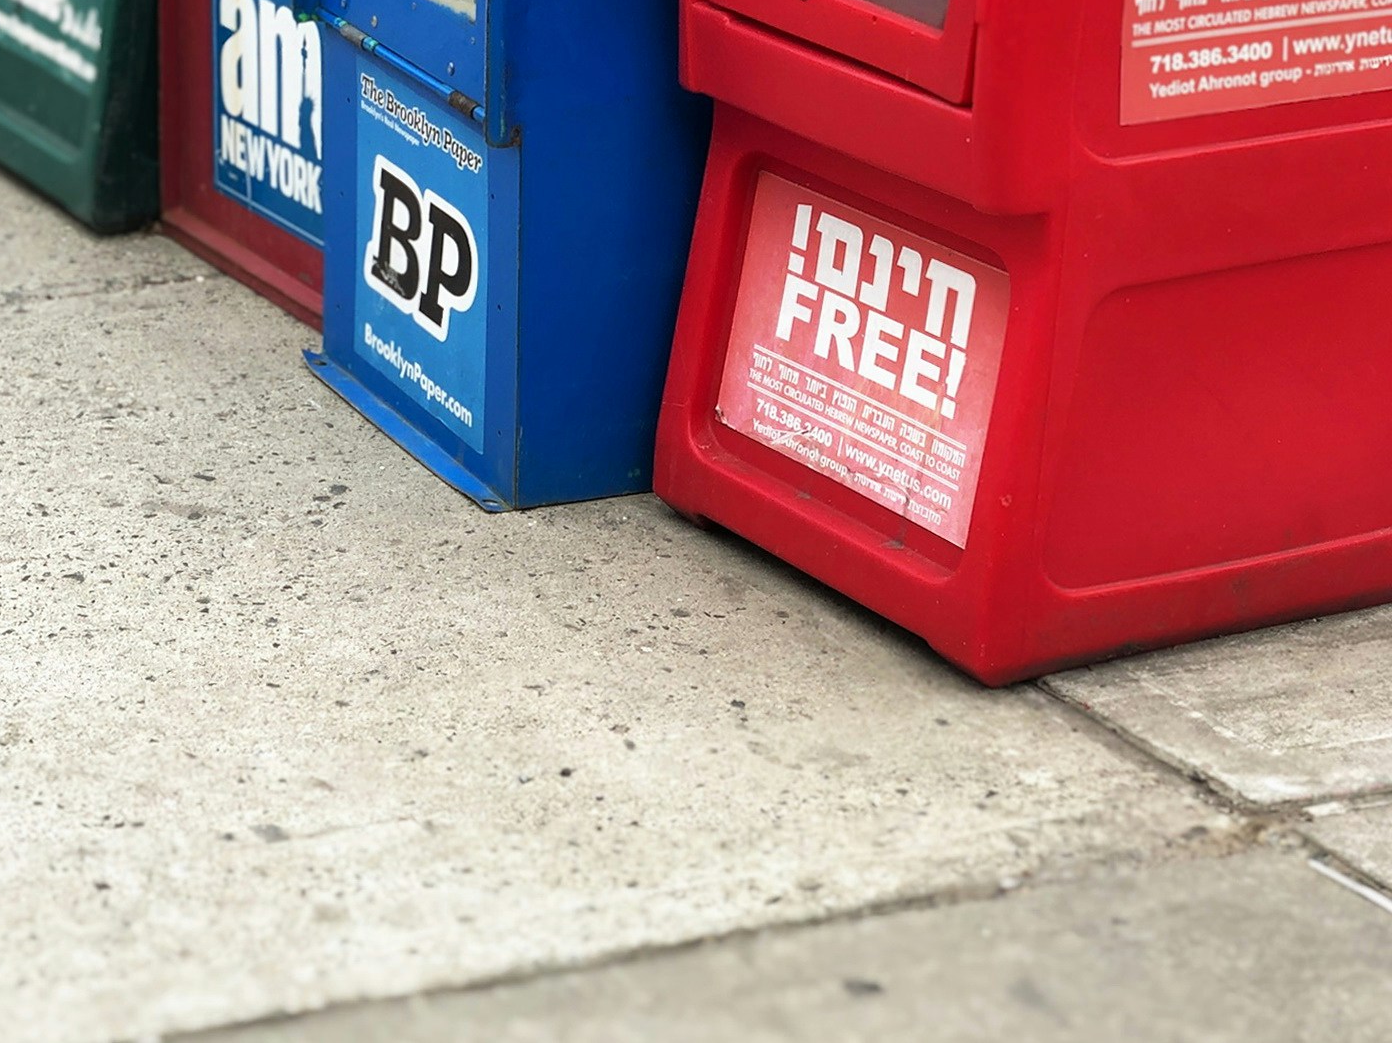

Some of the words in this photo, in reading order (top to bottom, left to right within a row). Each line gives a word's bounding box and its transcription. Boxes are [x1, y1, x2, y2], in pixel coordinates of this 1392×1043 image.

[1132, 23, 1152, 37] THE
[1154, 17, 1185, 34] MOST
[1188, 9, 1251, 30] CIRCULATED
[1254, 2, 1300, 23] HEBREW
[1150, 41, 1273, 74] 718.386.3400
[361, 73, 384, 107] The
[385, 90, 441, 147] Brooklyn
[442, 127, 482, 173] Paper
[1149, 77, 1195, 99] Yediot
[1198, 71, 1256, 93] Ahronot
[1260, 67, 1302, 88] group
[369, 161, 475, 333] BP
[788, 204, 977, 349] חינם!
[364, 323, 473, 428] BrooklynPaper.com
[775, 274, 966, 420] FREE!
[749, 368, 762, 383] THE
[762, 374, 783, 392] MOST
[783, 386, 825, 413] CIRCULATED
[824, 405, 855, 428] HEBREW
[900, 441, 925, 463] COAST
[925, 454, 936, 468] TO
[936, 460, 961, 482] COAST
[819, 455, 849, 477] group
[845, 443, 953, 509] www.ynetus.com
